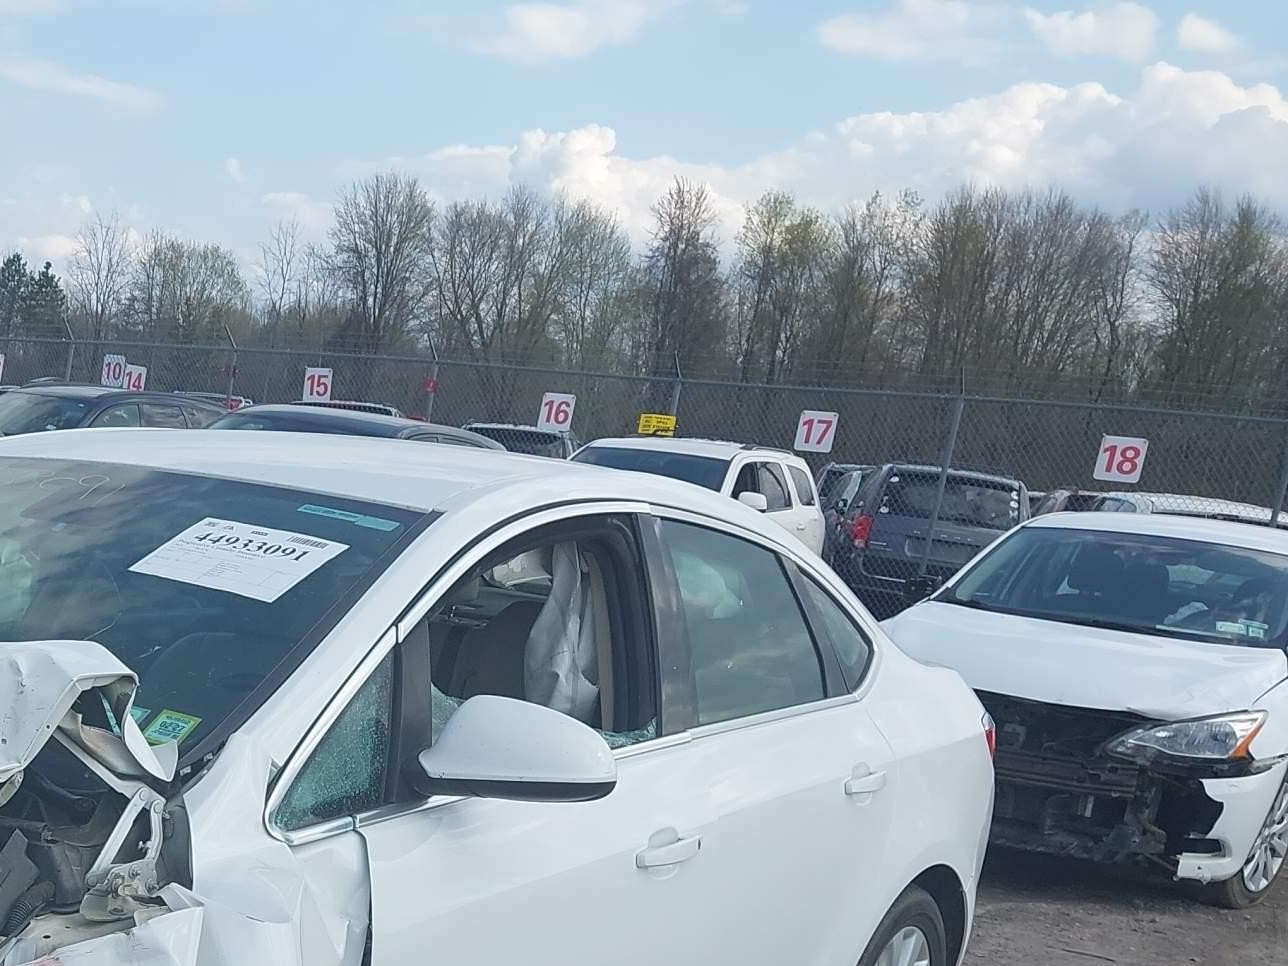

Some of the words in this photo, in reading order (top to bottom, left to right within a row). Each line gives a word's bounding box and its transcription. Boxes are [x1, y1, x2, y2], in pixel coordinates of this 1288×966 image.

[105, 362, 122, 380] 10
[126, 371, 142, 391] 14
[307, 374, 329, 397] 15
[544, 400, 570, 424] 16
[802, 418, 833, 445] 17
[1103, 445, 1141, 475] 18
[194, 532, 310, 561] 44933091
